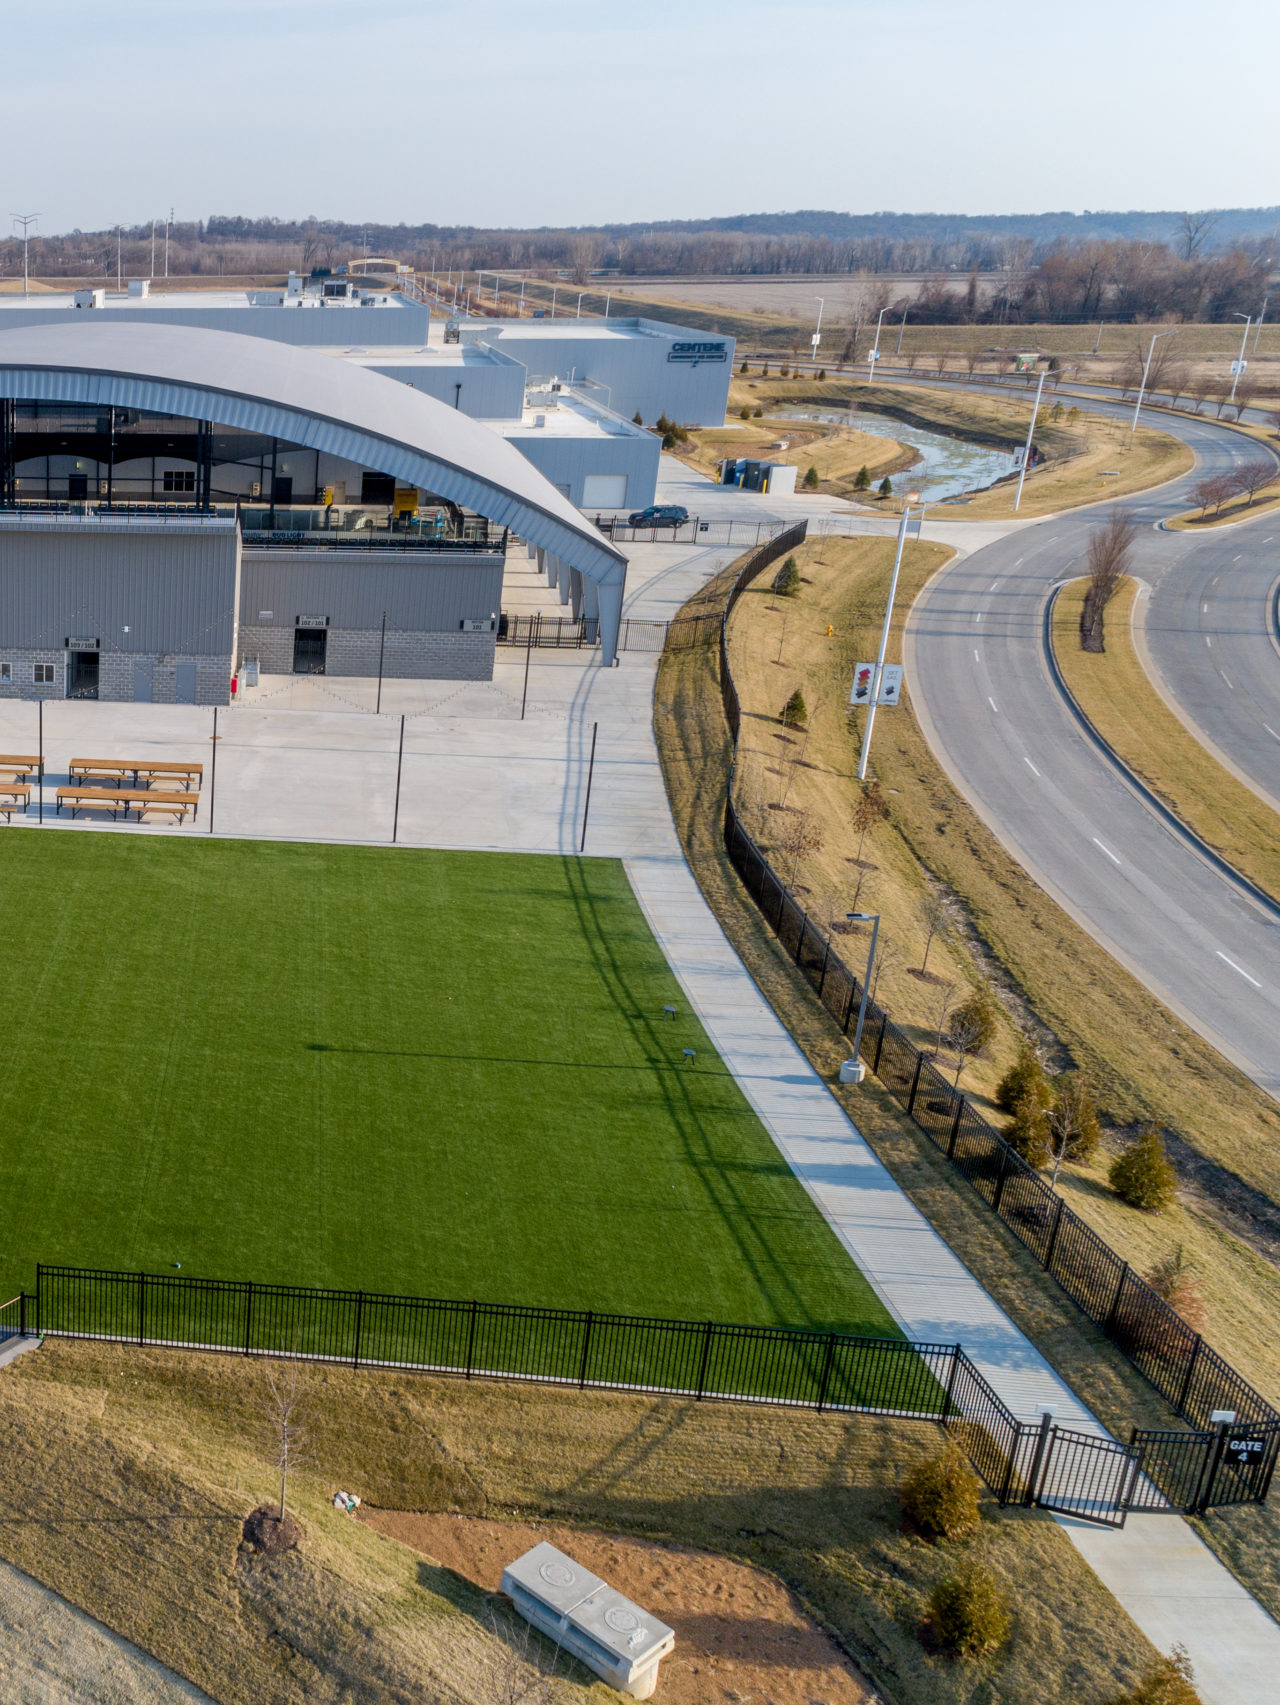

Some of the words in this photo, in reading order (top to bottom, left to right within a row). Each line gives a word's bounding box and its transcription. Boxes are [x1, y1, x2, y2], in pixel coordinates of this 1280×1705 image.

[672, 342, 726, 353] CENTENE
[1230, 1441, 1263, 1451] GATE
[1237, 1452, 1248, 1462] 4
